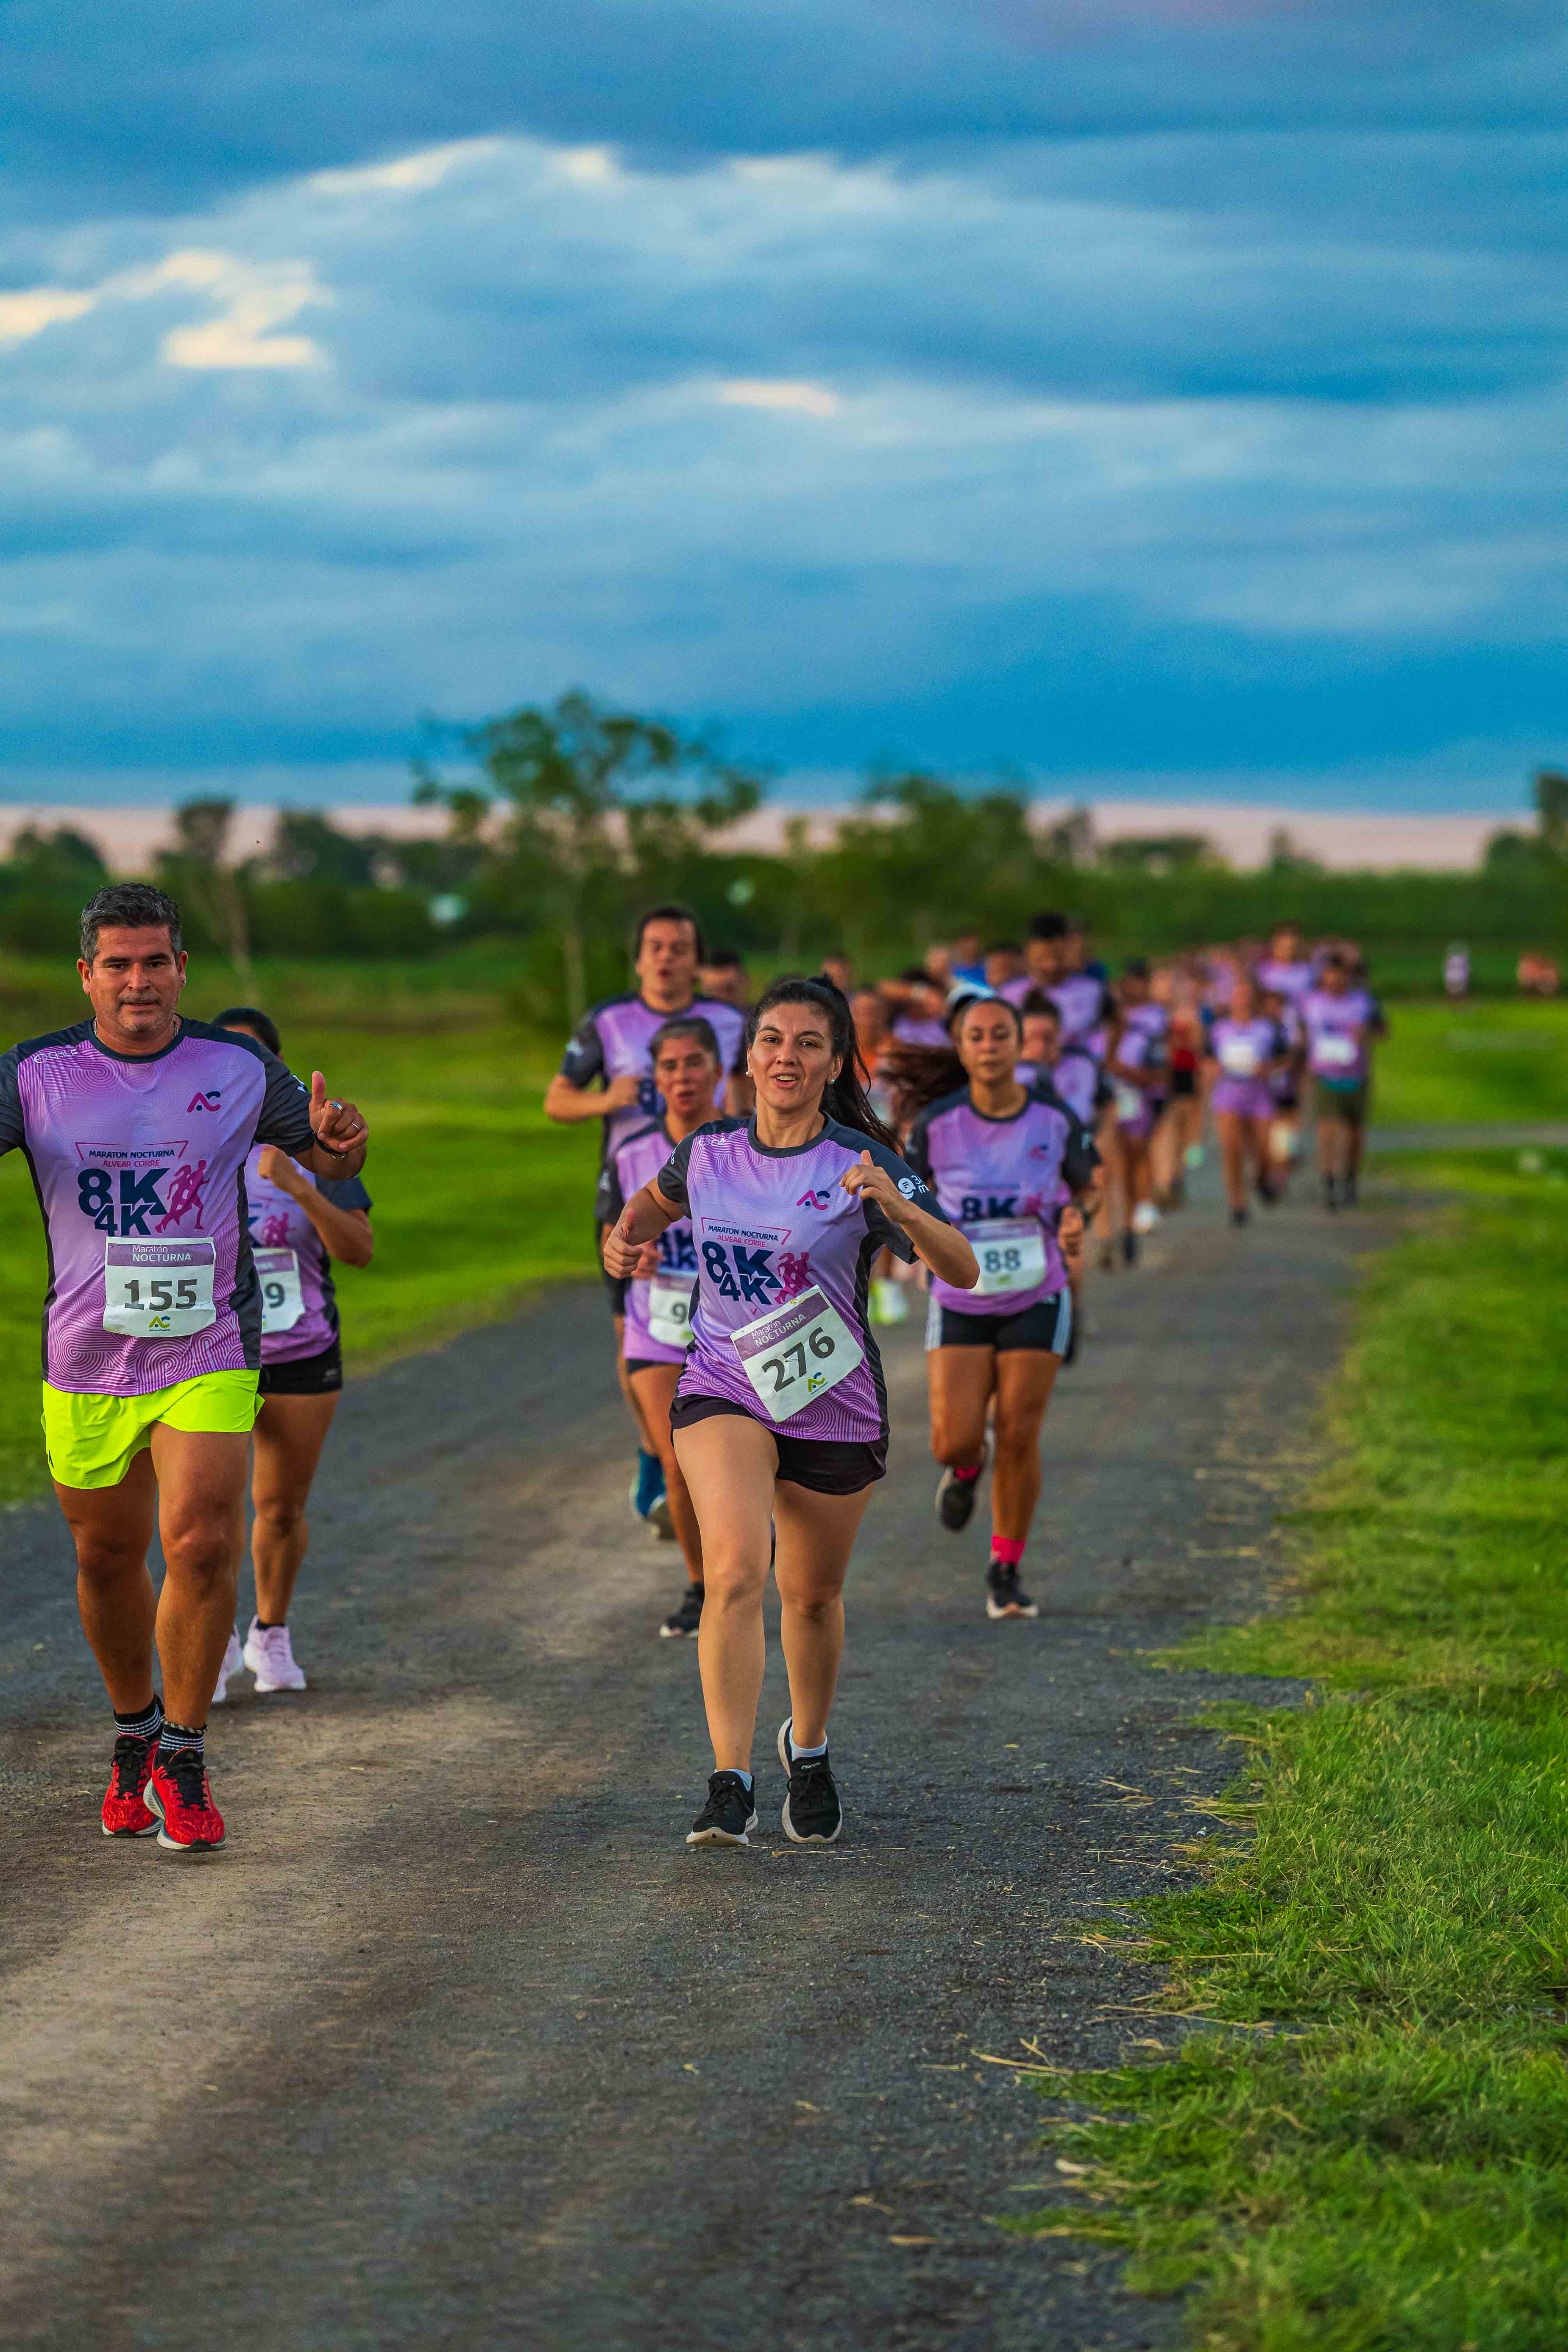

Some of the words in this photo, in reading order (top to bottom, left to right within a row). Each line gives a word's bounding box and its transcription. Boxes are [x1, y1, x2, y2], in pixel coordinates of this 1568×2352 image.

[89, 1150, 128, 1158] MARATON
[130, 1149, 175, 1158] NOCTURNA
[78, 1167, 171, 1217] 8K
[94, 1204, 152, 1236] 4K
[708, 1225, 739, 1235] MARATON
[741, 1230, 778, 1241] NOCTURNA
[718, 1234, 742, 1243] ALVEAR
[744, 1238, 766, 1247] CORRE
[133, 1253, 191, 1262] NOCTURNA
[702, 1241, 783, 1289] 8K
[984, 1248, 1022, 1273] 88
[124, 1279, 197, 1311] 155
[264, 1282, 285, 1309] 9
[719, 1273, 772, 1305] 4K
[671, 1302, 687, 1325] 9
[752, 1319, 780, 1339] Maratón
[755, 1314, 806, 1347] NOCTURNA
[762, 1327, 835, 1392] 276
